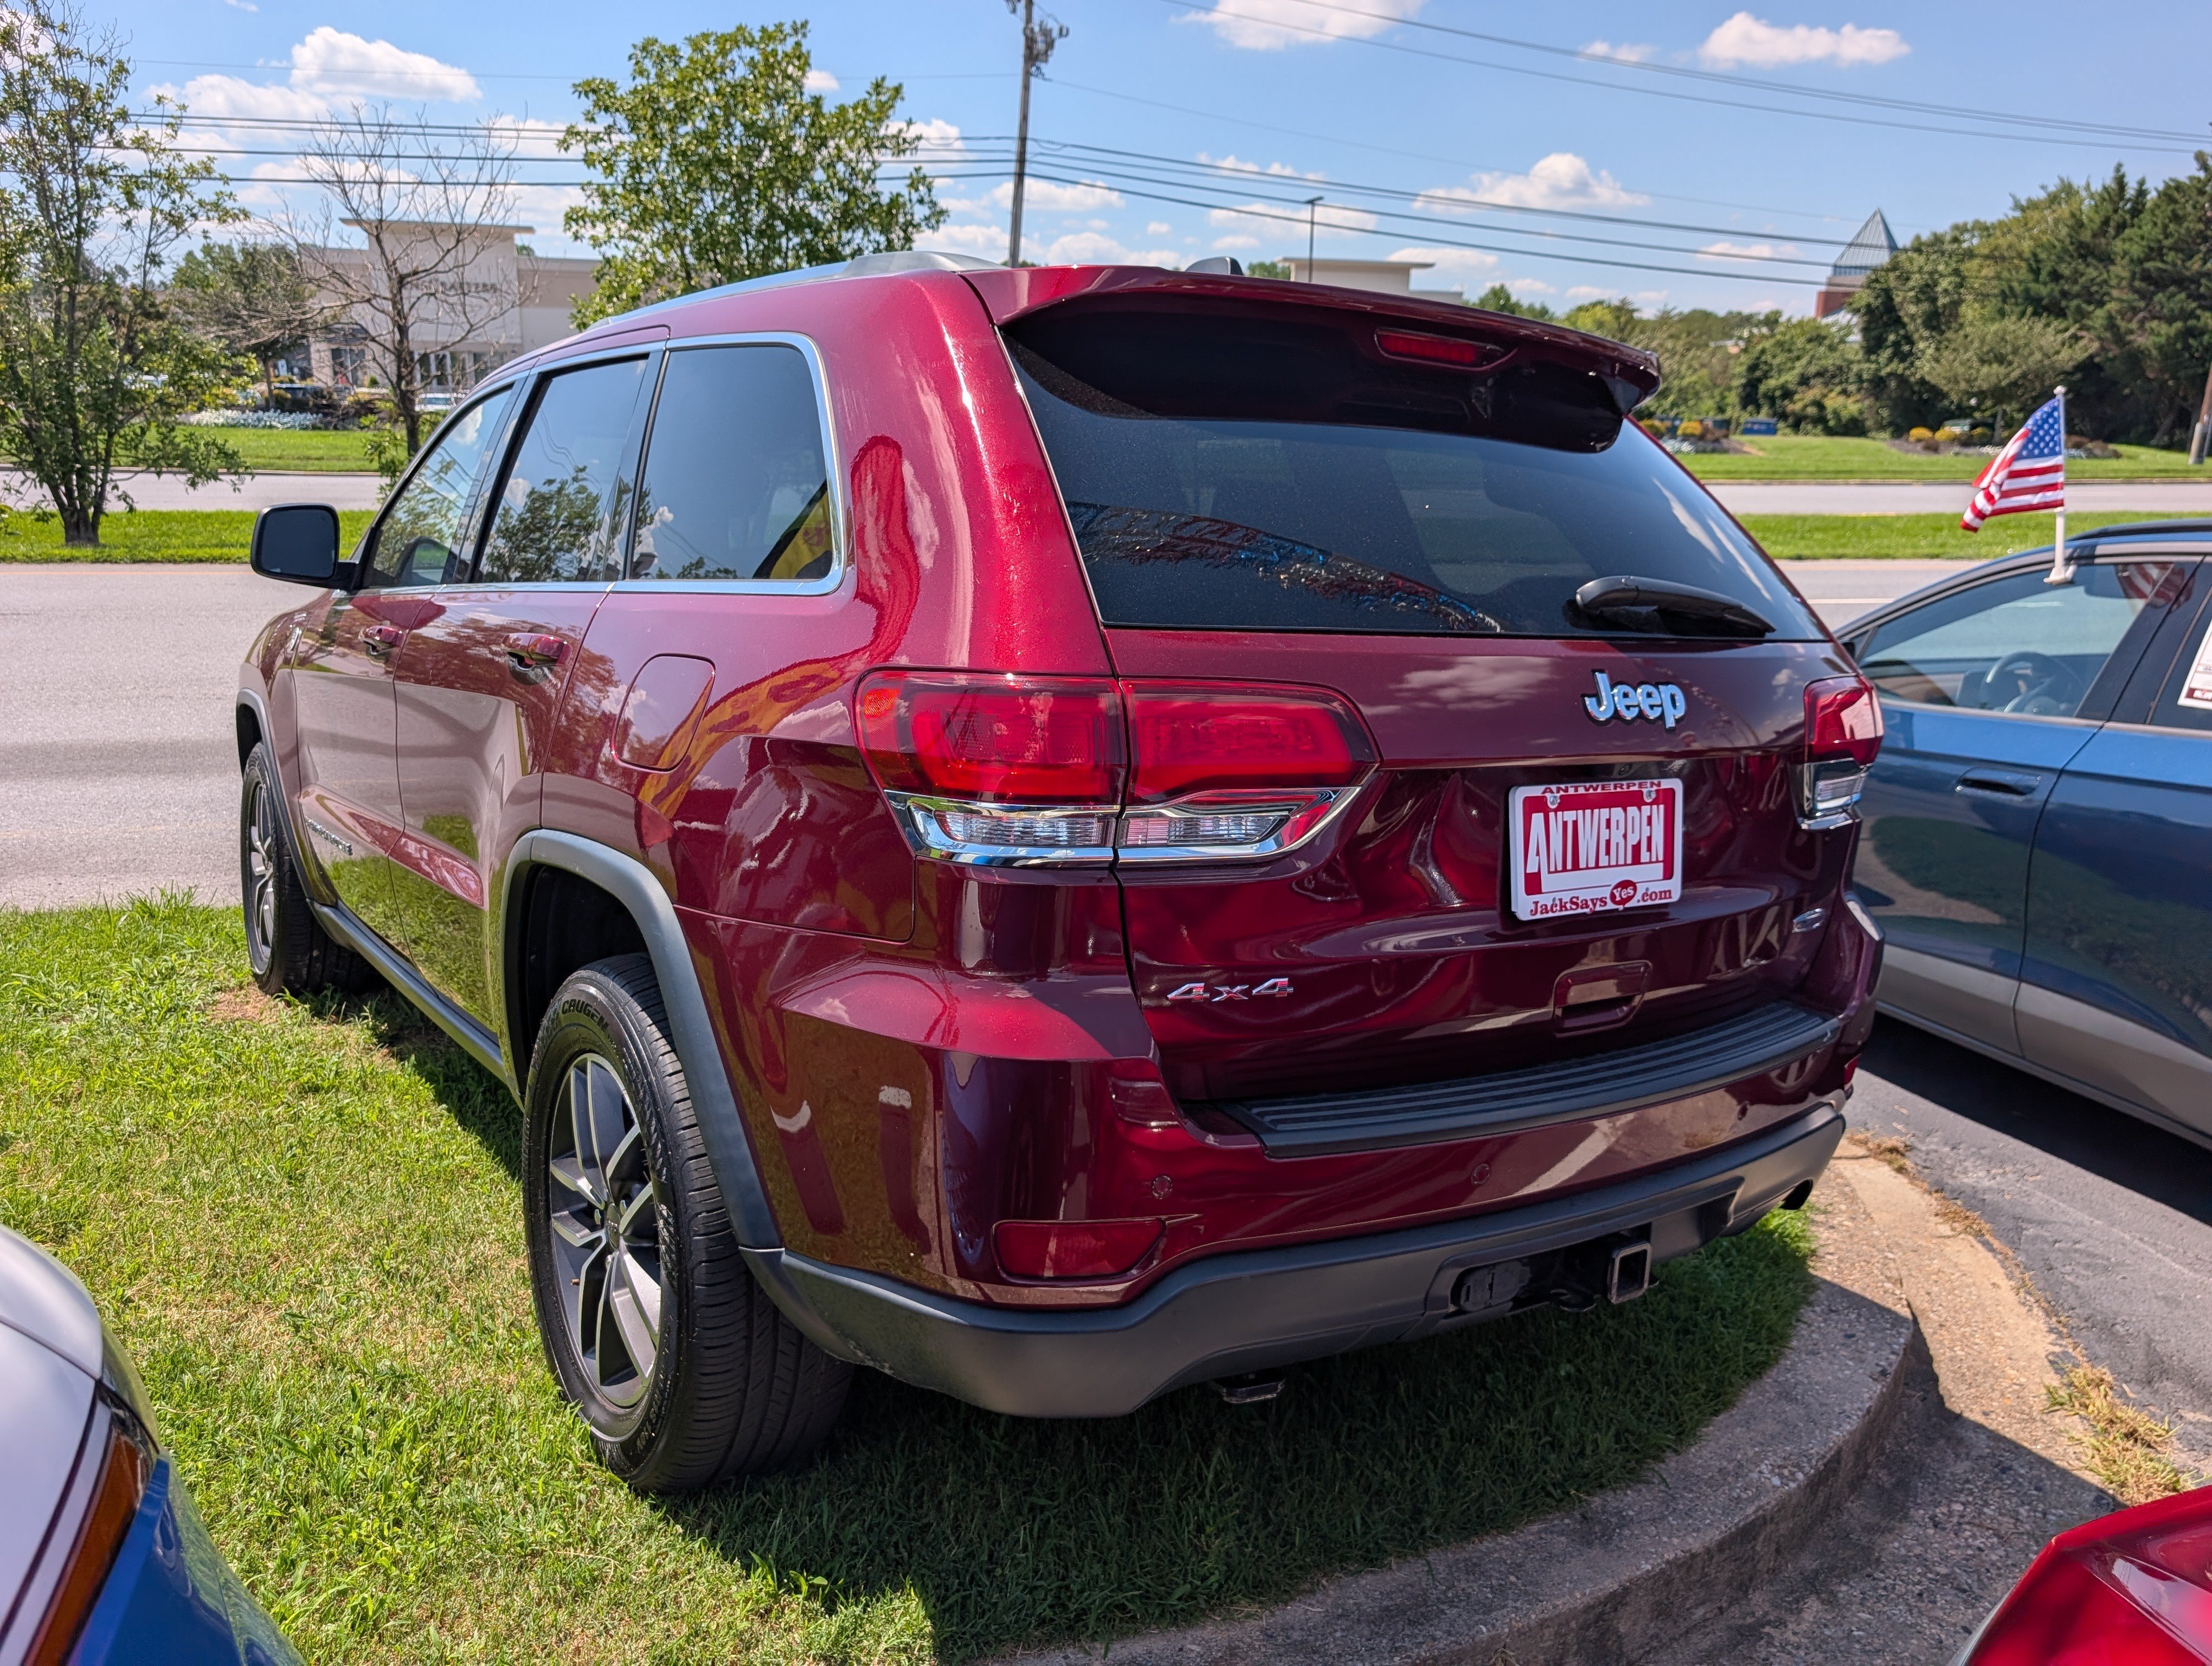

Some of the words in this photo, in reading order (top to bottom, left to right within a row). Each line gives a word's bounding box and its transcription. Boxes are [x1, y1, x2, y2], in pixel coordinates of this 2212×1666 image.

[1583, 671, 1686, 729] Jeep
[1541, 780, 1662, 794] ANTWERPEN
[1526, 804, 1664, 874] ANTWERPEN
